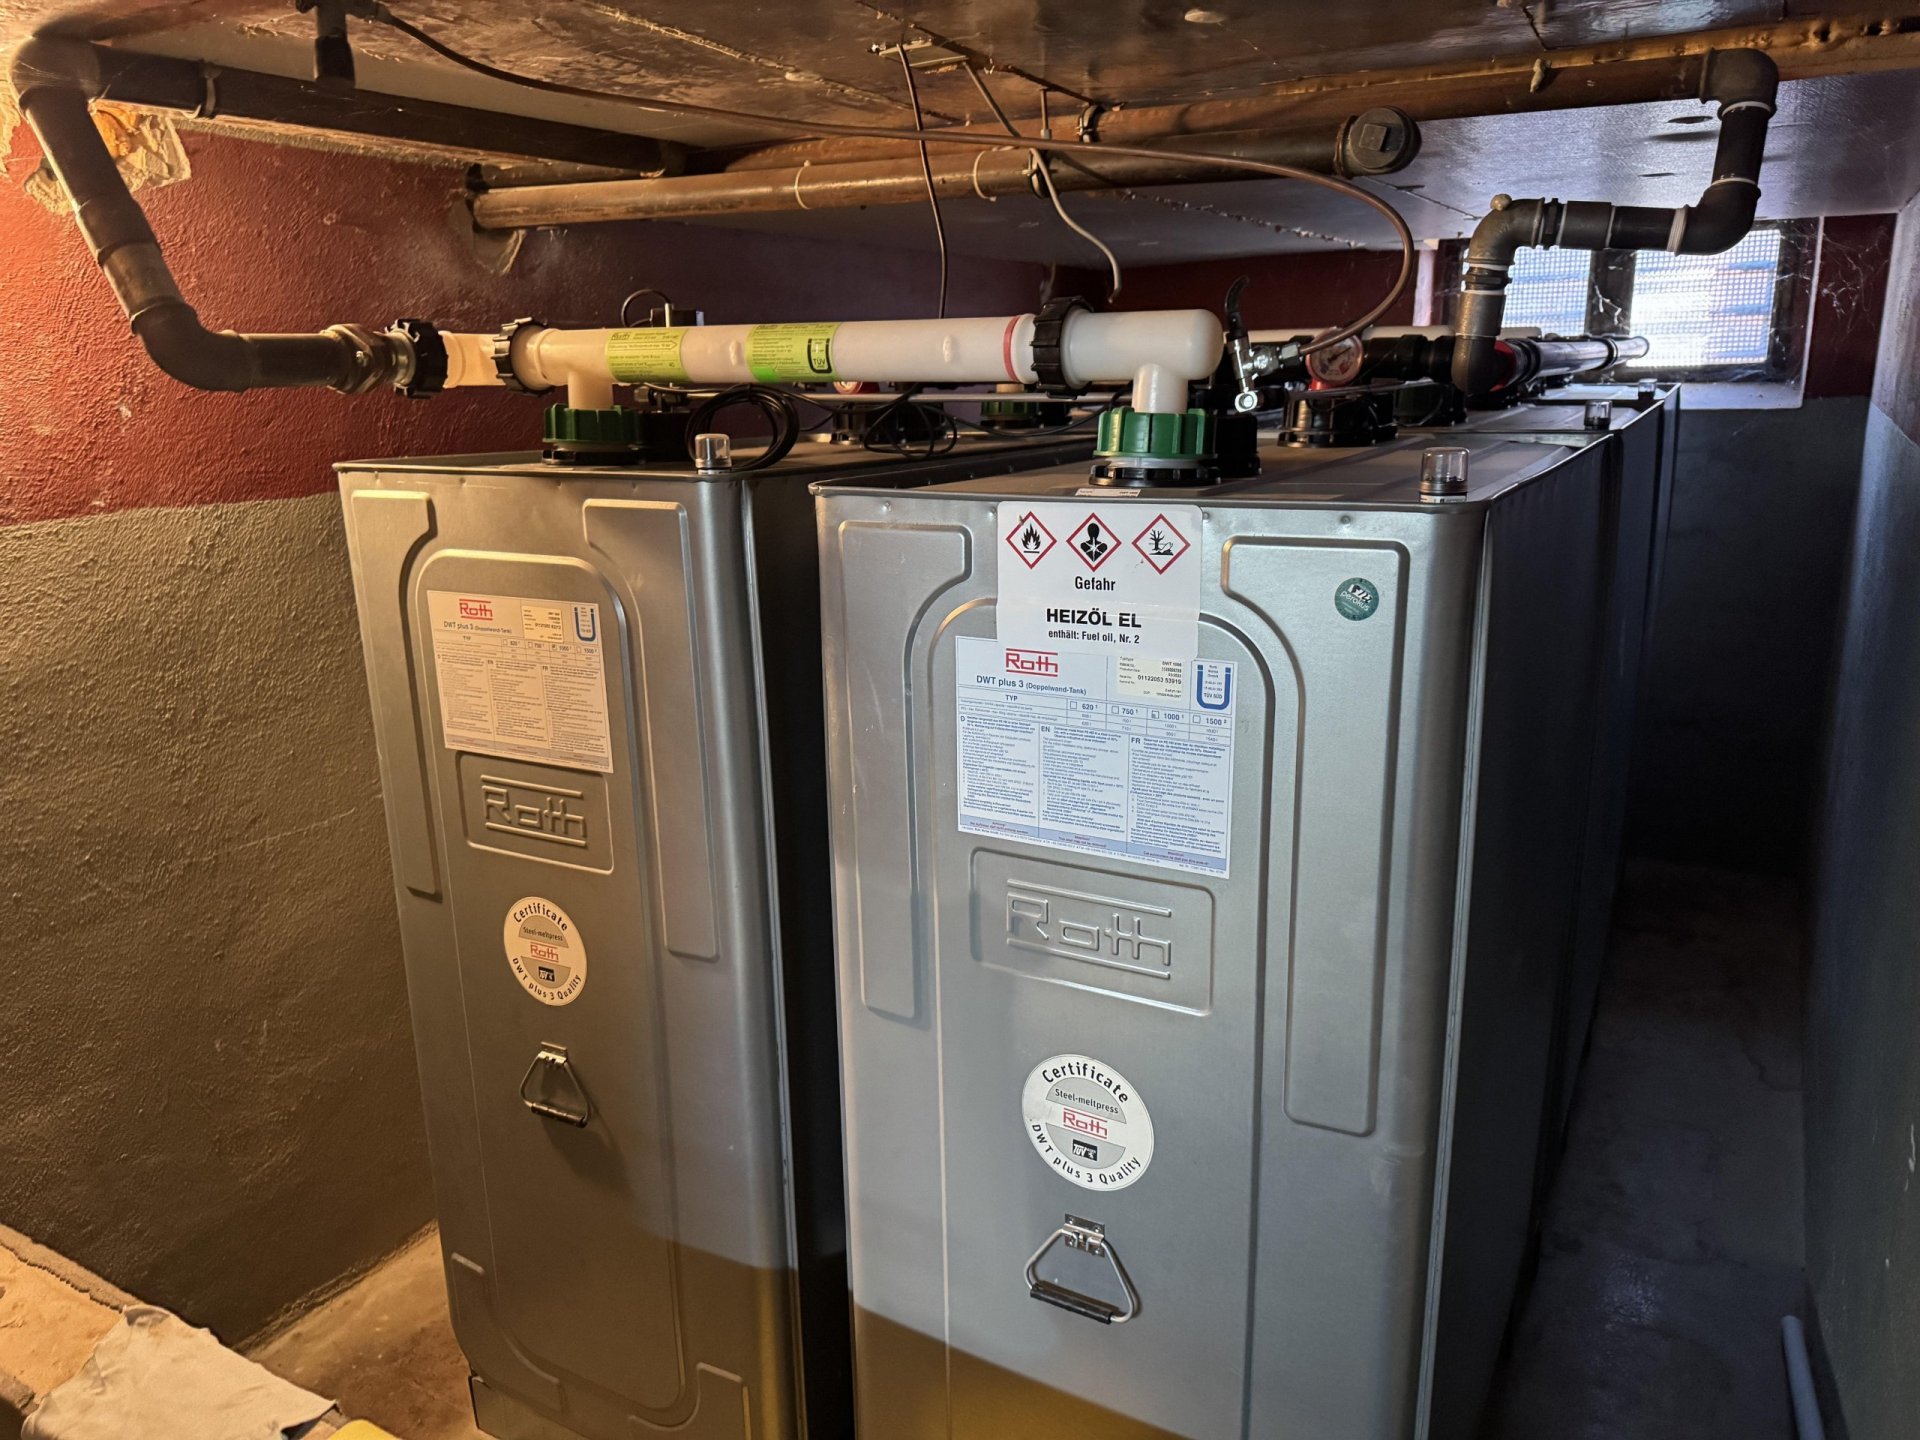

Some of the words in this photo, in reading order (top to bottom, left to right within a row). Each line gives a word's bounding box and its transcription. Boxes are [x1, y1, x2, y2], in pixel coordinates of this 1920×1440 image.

[1075, 576, 1116, 591] Gefahr
[459, 602, 493, 618] Roth
[1046, 608, 1112, 627] HEIZÖL
[1118, 613, 1142, 628] EL
[1048, 629, 1080, 641] enthält:
[1081, 631, 1100, 641] Fuel
[1102, 632, 1117, 644] oil,
[1119, 634, 1132, 644] Nr.
[1134, 634, 1140, 644] 2
[1006, 652, 1058, 673] Roth
[976, 675, 996, 685] DWT
[998, 678, 1016, 688] plus
[1018, 680, 1024, 688] 3
[1082, 702, 1094, 710] 620
[1206, 718, 1222, 726] 1500
[482, 784, 587, 838] Roth
[514, 902, 568, 932] Certificate
[1006, 892, 1172, 966] Roth
[530, 944, 559, 961] Roth
[512, 957, 528, 980] DWT
[529, 983, 547, 998] plus
[550, 992, 554, 1000] 3
[557, 974, 581, 1000] Quality
[1042, 1062, 1128, 1103] Certificate
[1055, 1088, 1118, 1114] Steel-meltpress
[1063, 1111, 1108, 1136] Roth
[1032, 1124, 1054, 1153] DWT
[1053, 1157, 1080, 1178] plus
[1087, 1173, 1093, 1183] 3
[1100, 1156, 1141, 1185] Quality
